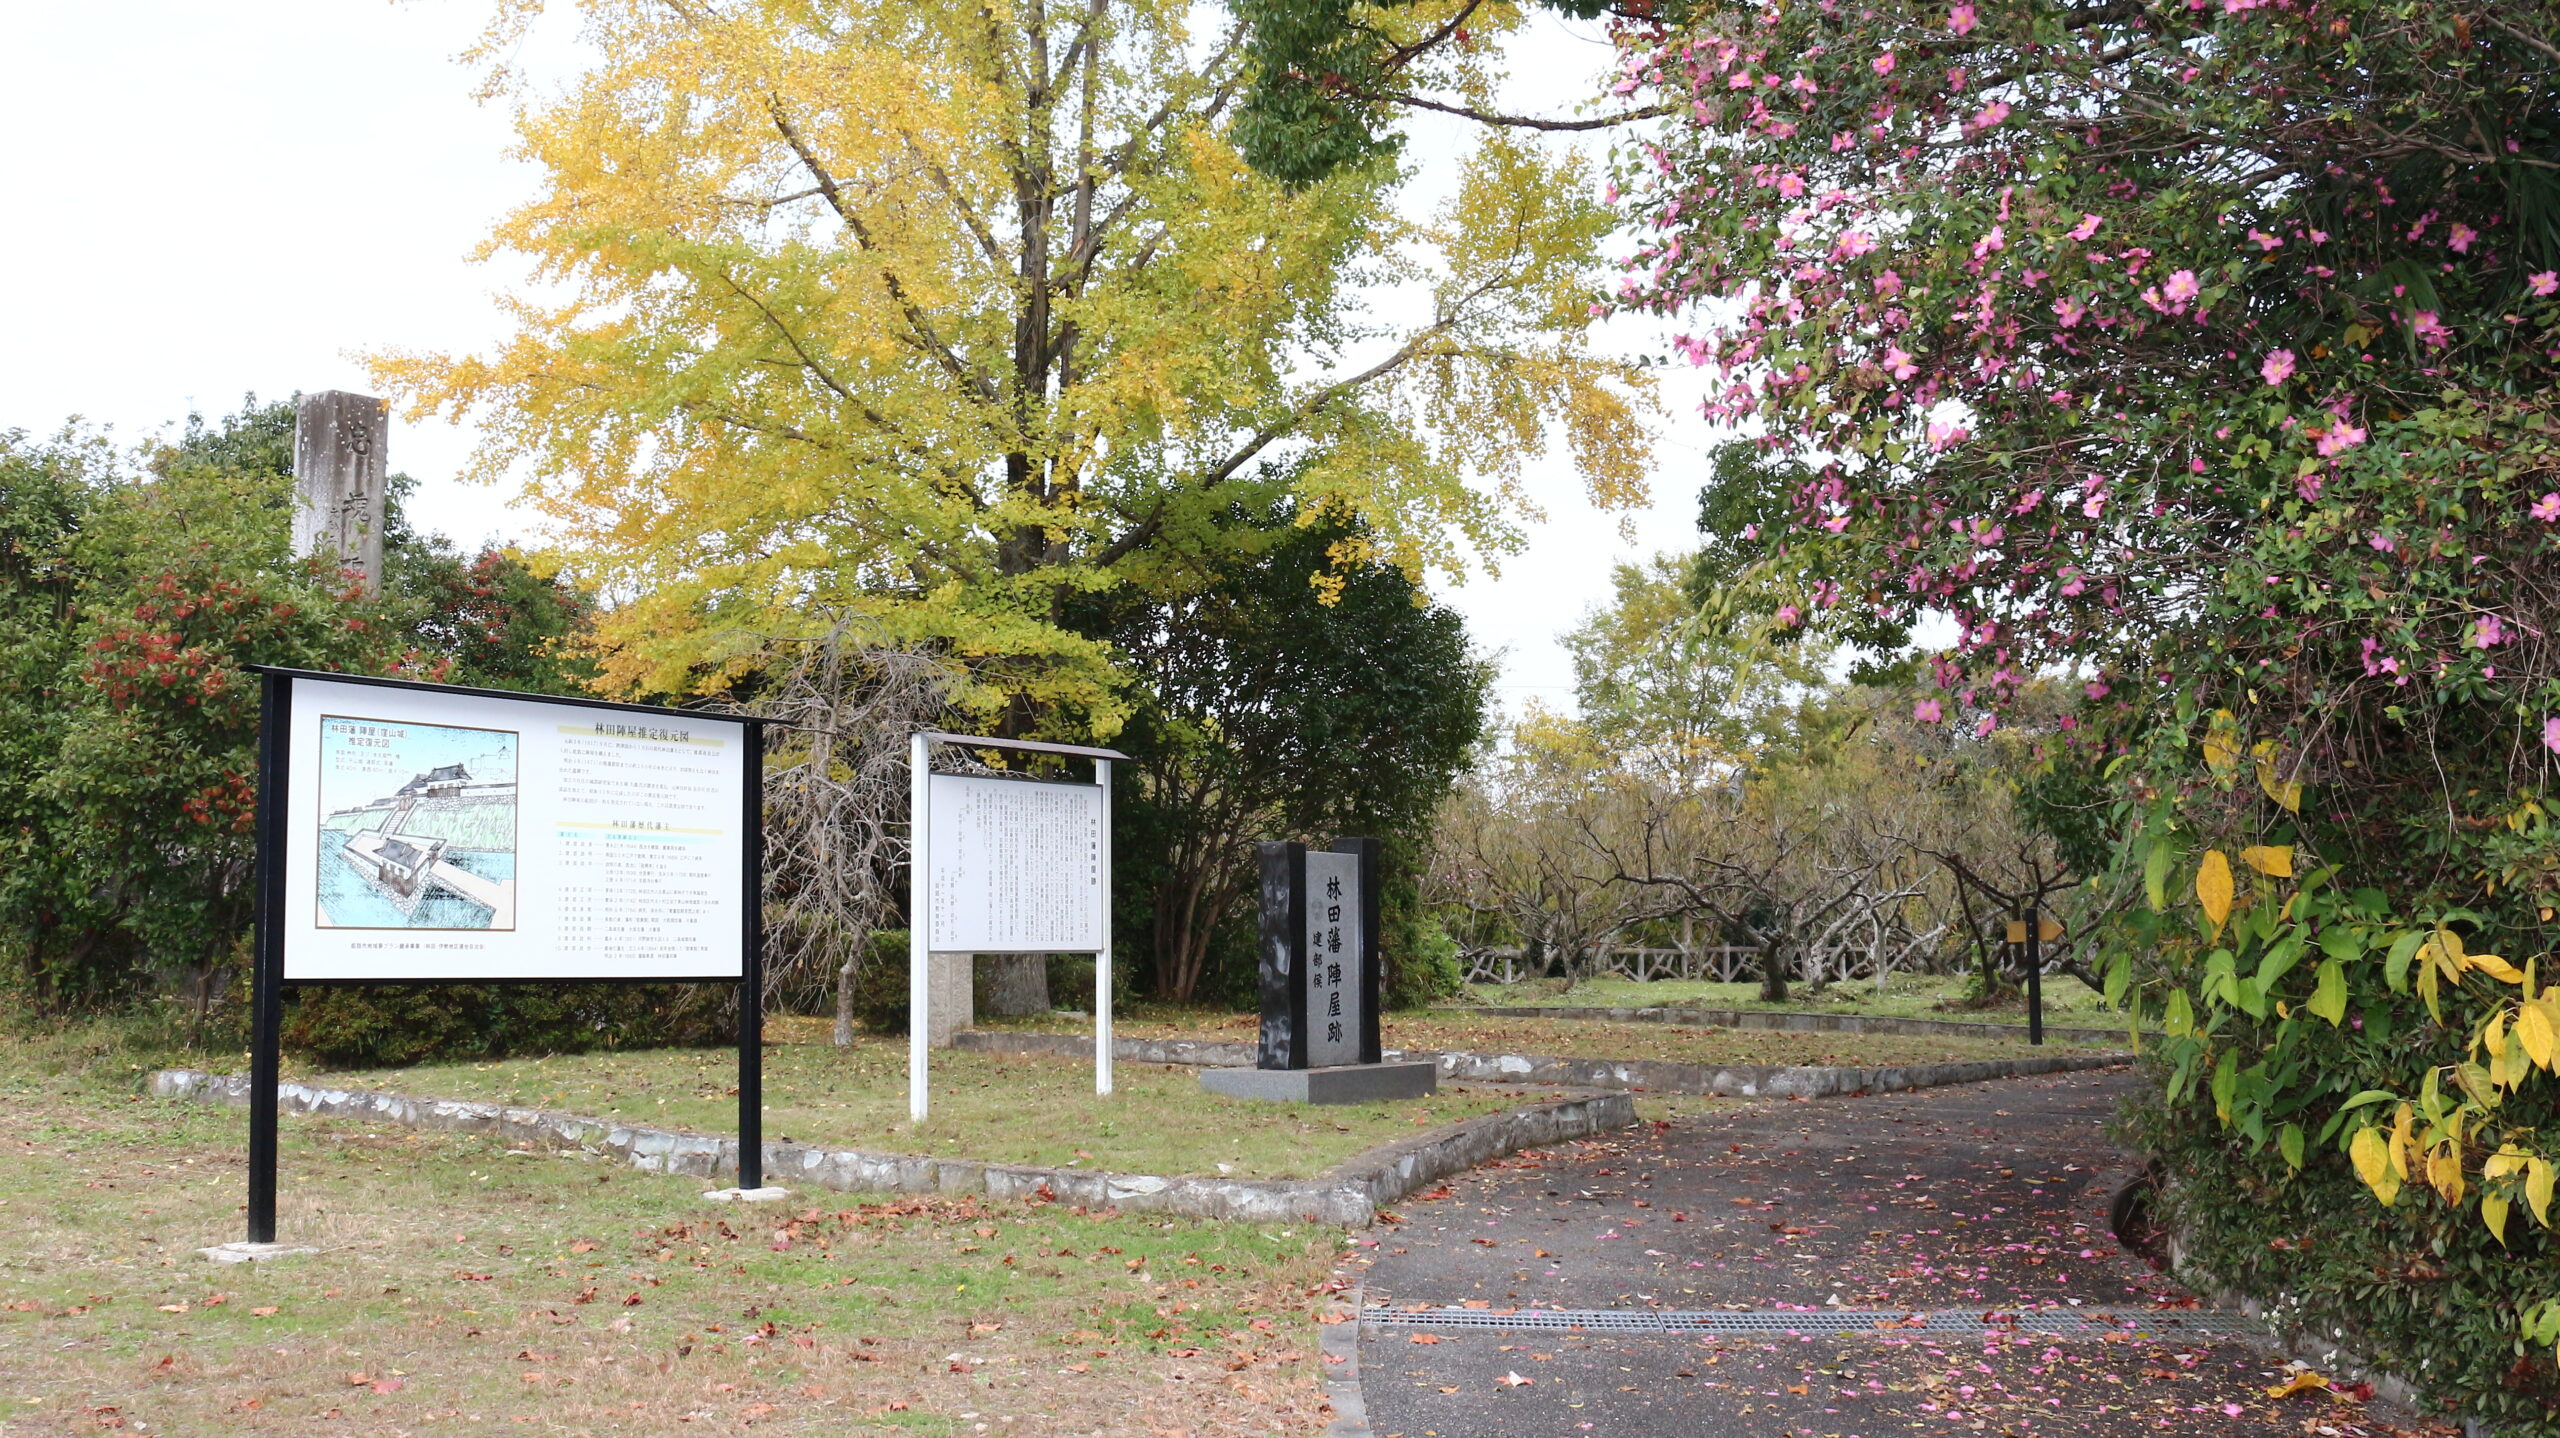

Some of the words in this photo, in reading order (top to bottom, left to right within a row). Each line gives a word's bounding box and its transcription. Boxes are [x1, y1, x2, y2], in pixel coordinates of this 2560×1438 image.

[595, 721, 689, 742] 林田陣屋推定復元図
[1326, 876, 1343, 1043] 林田藩陣屋跡
